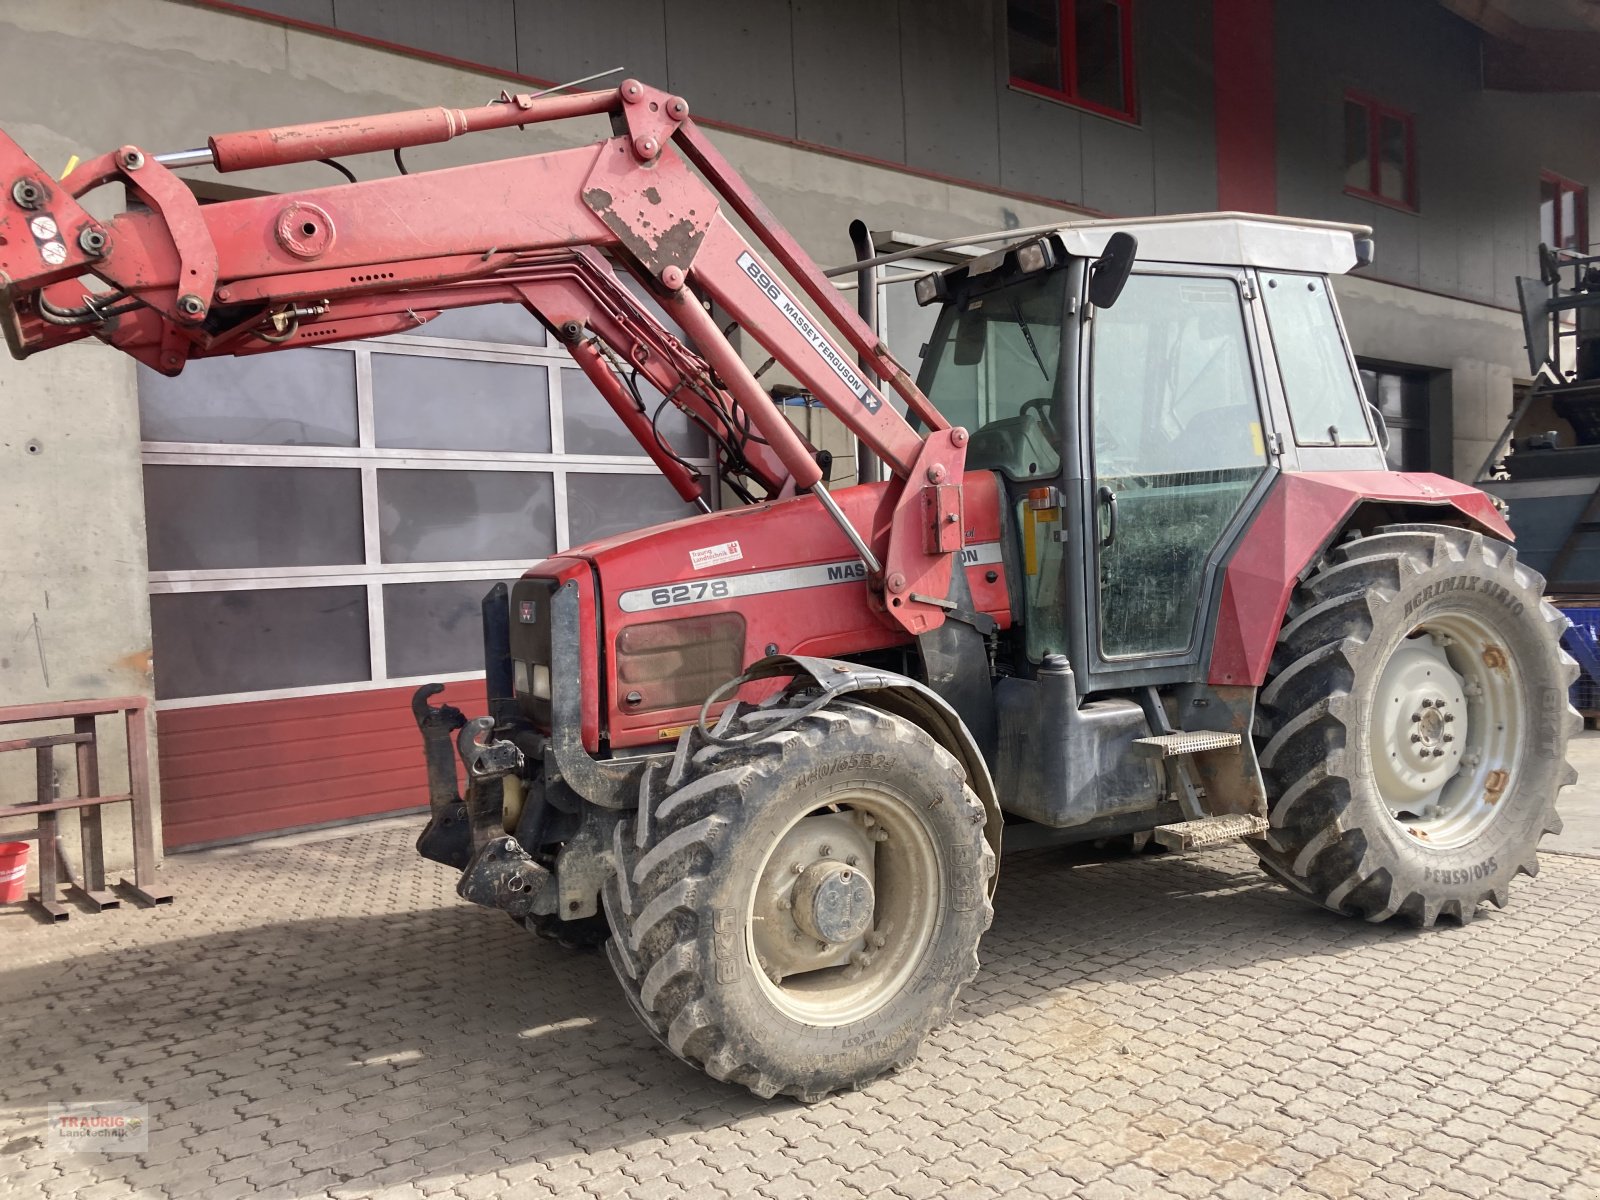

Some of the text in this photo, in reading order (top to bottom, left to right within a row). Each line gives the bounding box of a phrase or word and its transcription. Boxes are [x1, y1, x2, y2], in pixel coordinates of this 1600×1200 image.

[746, 262, 862, 391] 896 MASSEY FERGUSON
[692, 551, 728, 564] Landtechnik
[651, 580, 729, 606] 6278
[1403, 575, 1525, 620] AGRIMAX SIRIO
[1424, 855, 1499, 885] 540/65R34
